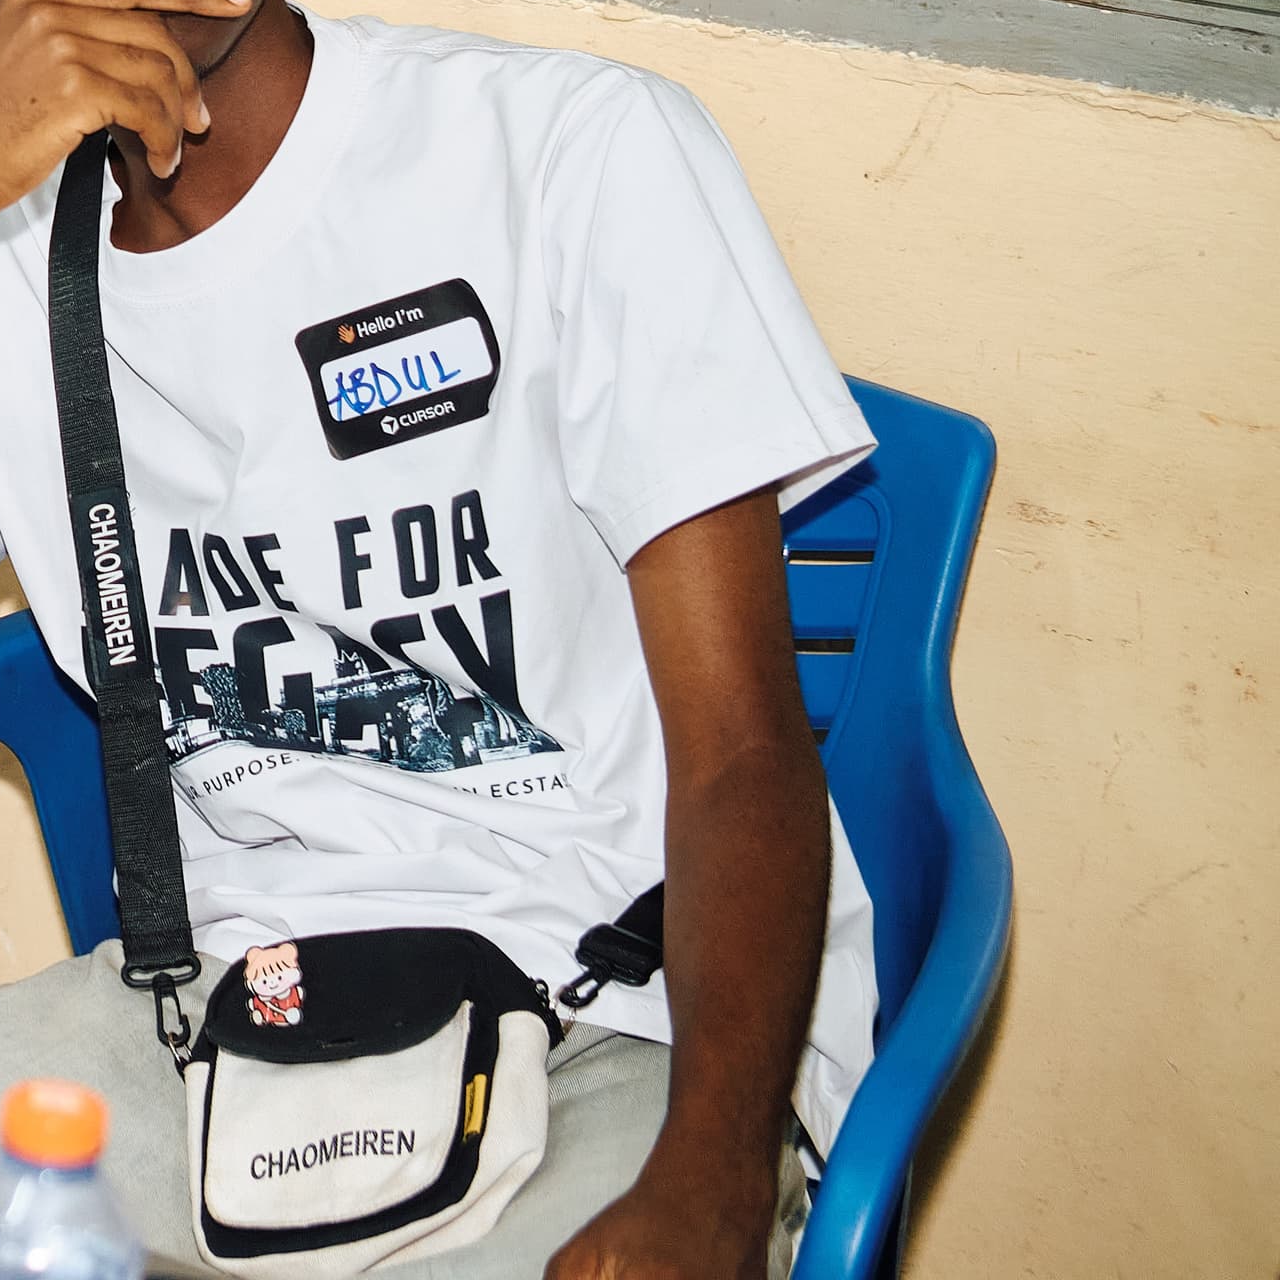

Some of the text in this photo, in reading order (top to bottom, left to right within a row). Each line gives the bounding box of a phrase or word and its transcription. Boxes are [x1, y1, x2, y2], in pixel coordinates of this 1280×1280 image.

[356, 306, 424, 338] Hello I'm
[327, 350, 461, 422] ABDUL
[399, 400, 457, 427] CURSOR
[158, 488, 503, 616] ADE FOR
[88, 503, 137, 667] CHAOMEIREN
[202, 752, 301, 795] PURPOSE.
[250, 1128, 417, 1181] CHAOMEIREN
